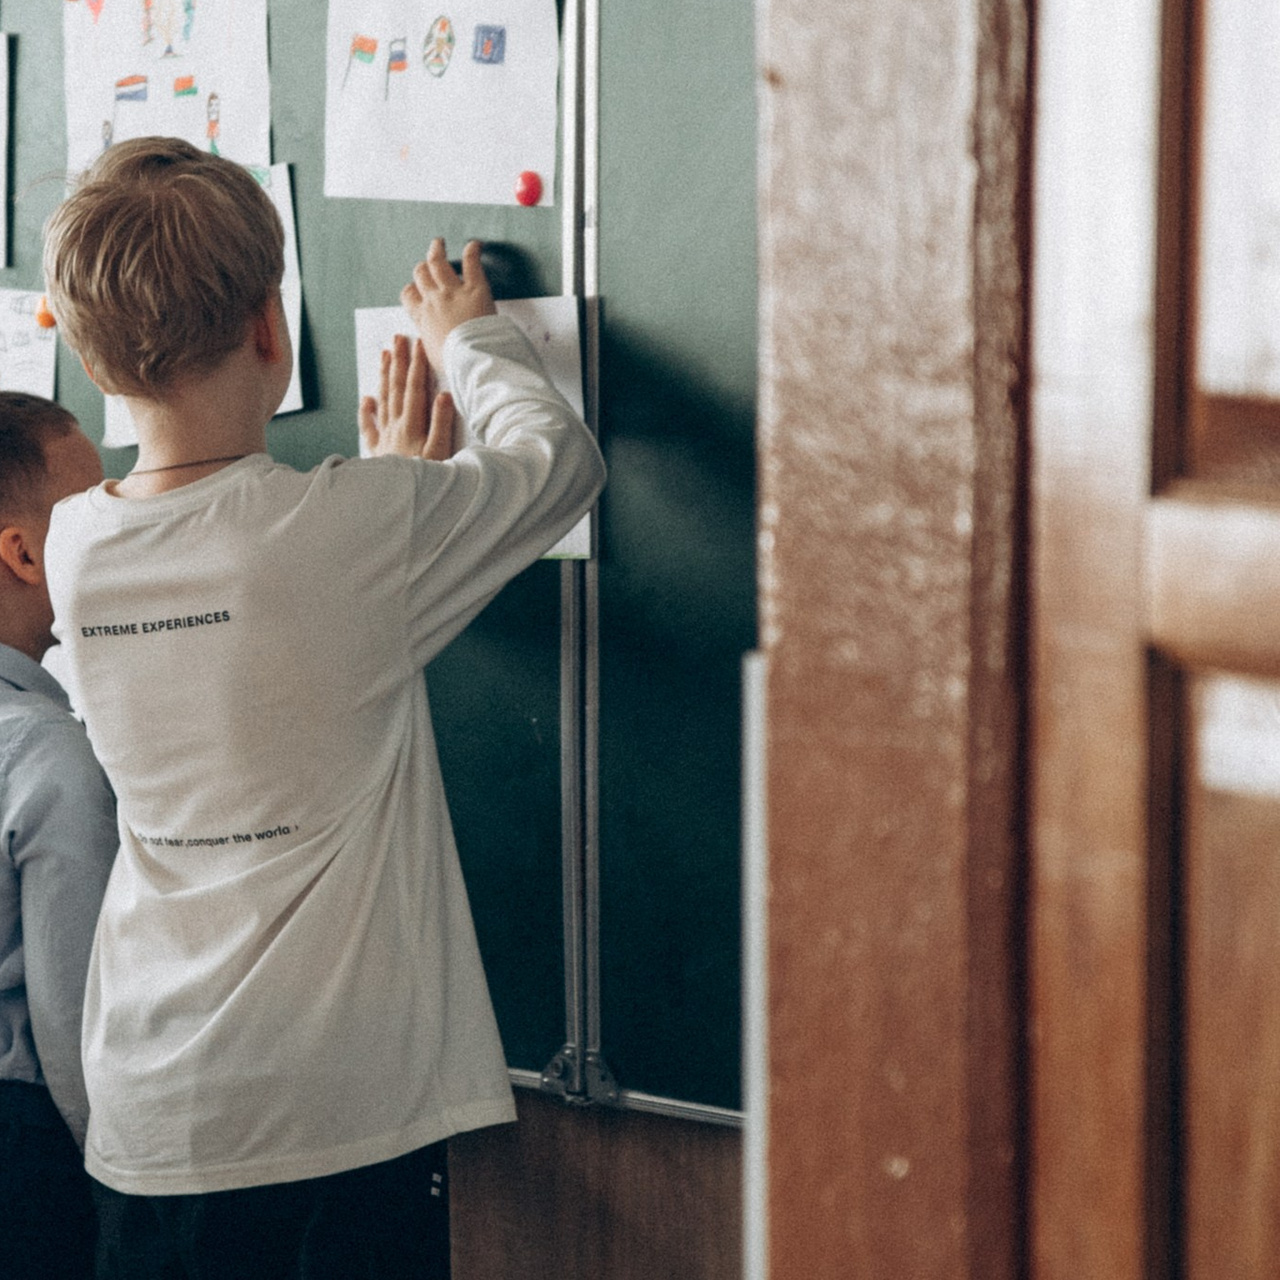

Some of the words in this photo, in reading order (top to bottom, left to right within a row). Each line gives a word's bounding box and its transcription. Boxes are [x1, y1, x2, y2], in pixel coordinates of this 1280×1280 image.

[81, 622, 139, 638] EXTREME
[142, 609, 231, 634] EXPERIENCES
[232, 832, 252, 844] the
